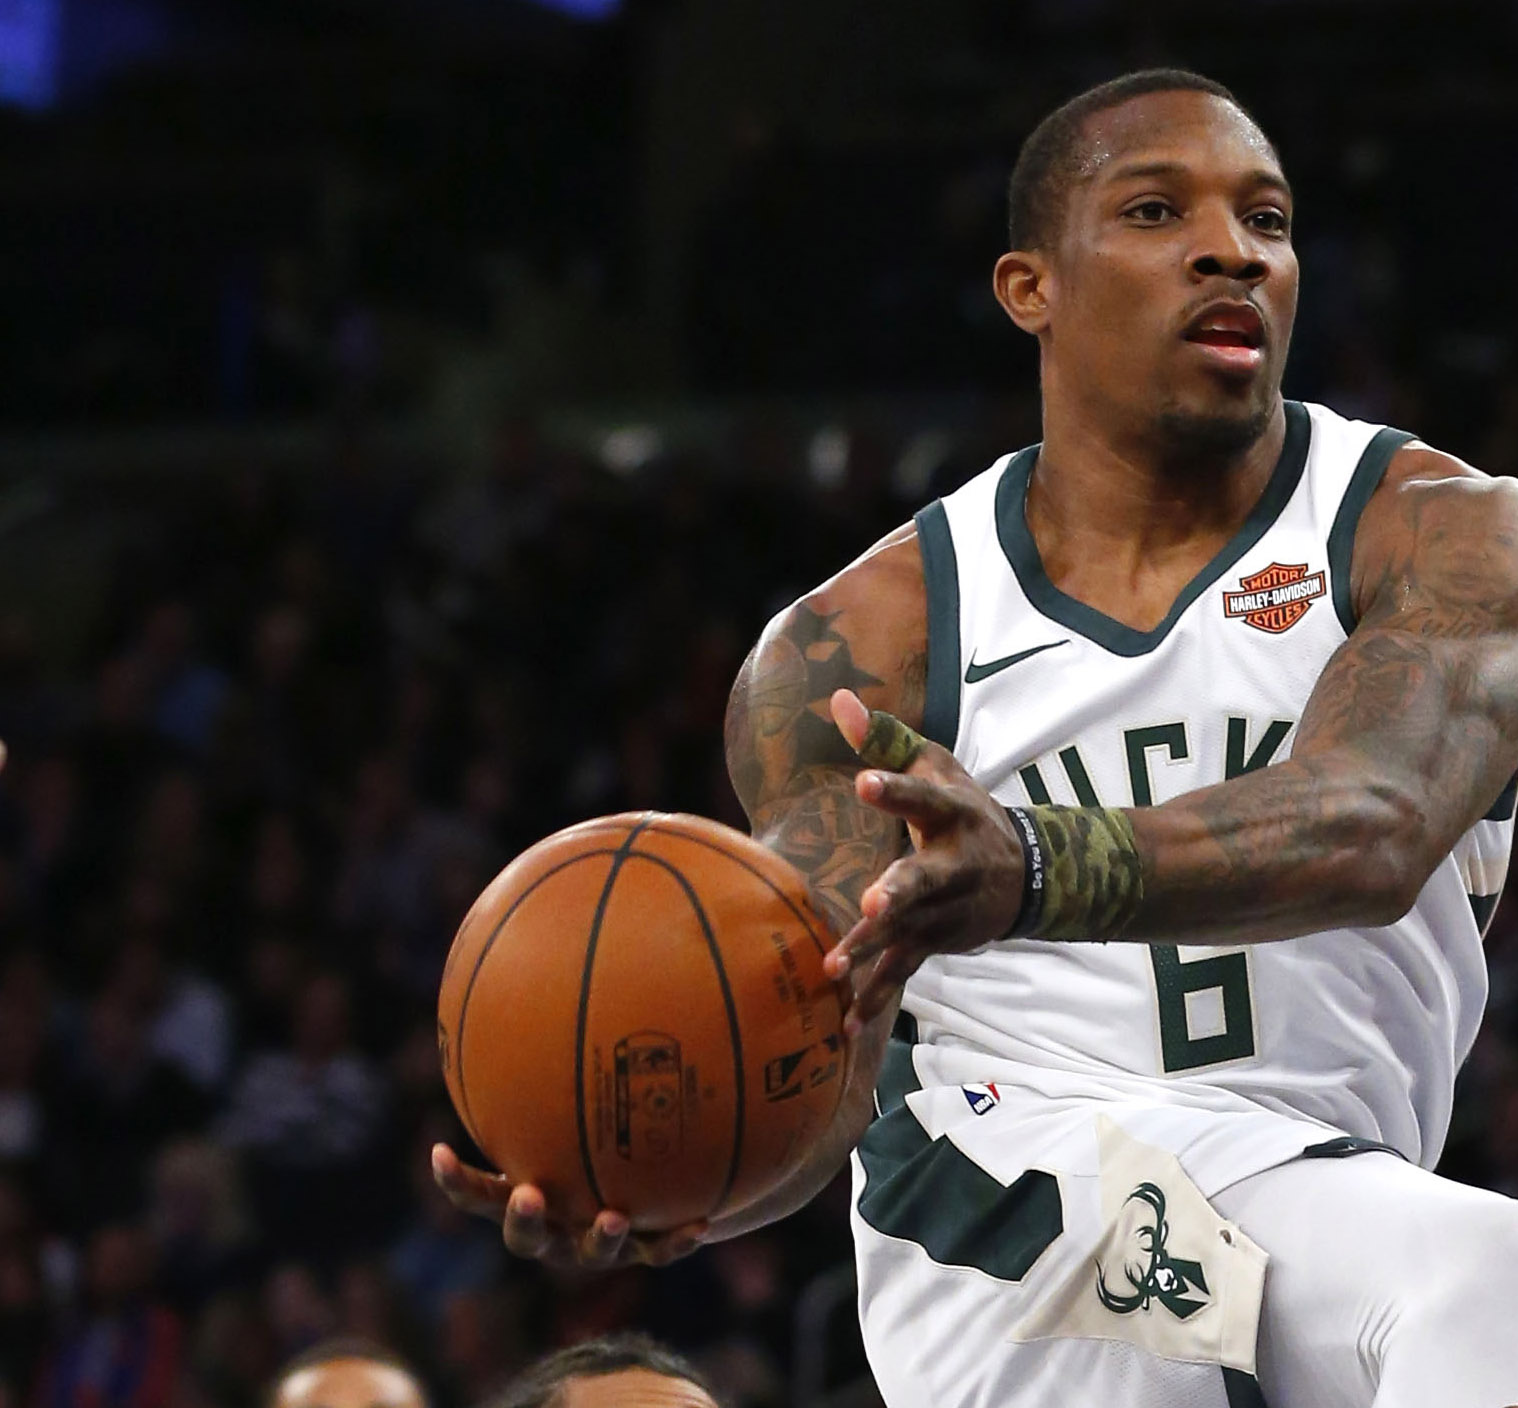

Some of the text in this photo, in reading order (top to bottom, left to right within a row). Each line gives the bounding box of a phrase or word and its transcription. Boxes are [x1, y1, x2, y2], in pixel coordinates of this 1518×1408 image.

[1251, 569, 1299, 589] MOTOR
[1230, 577, 1321, 612] HARLEY-DAVIDSON
[1254, 604, 1301, 628] CYCLES
[1031, 846, 1042, 871] You
[1032, 873, 1043, 889] Do
[1149, 943, 1257, 1074] 6
